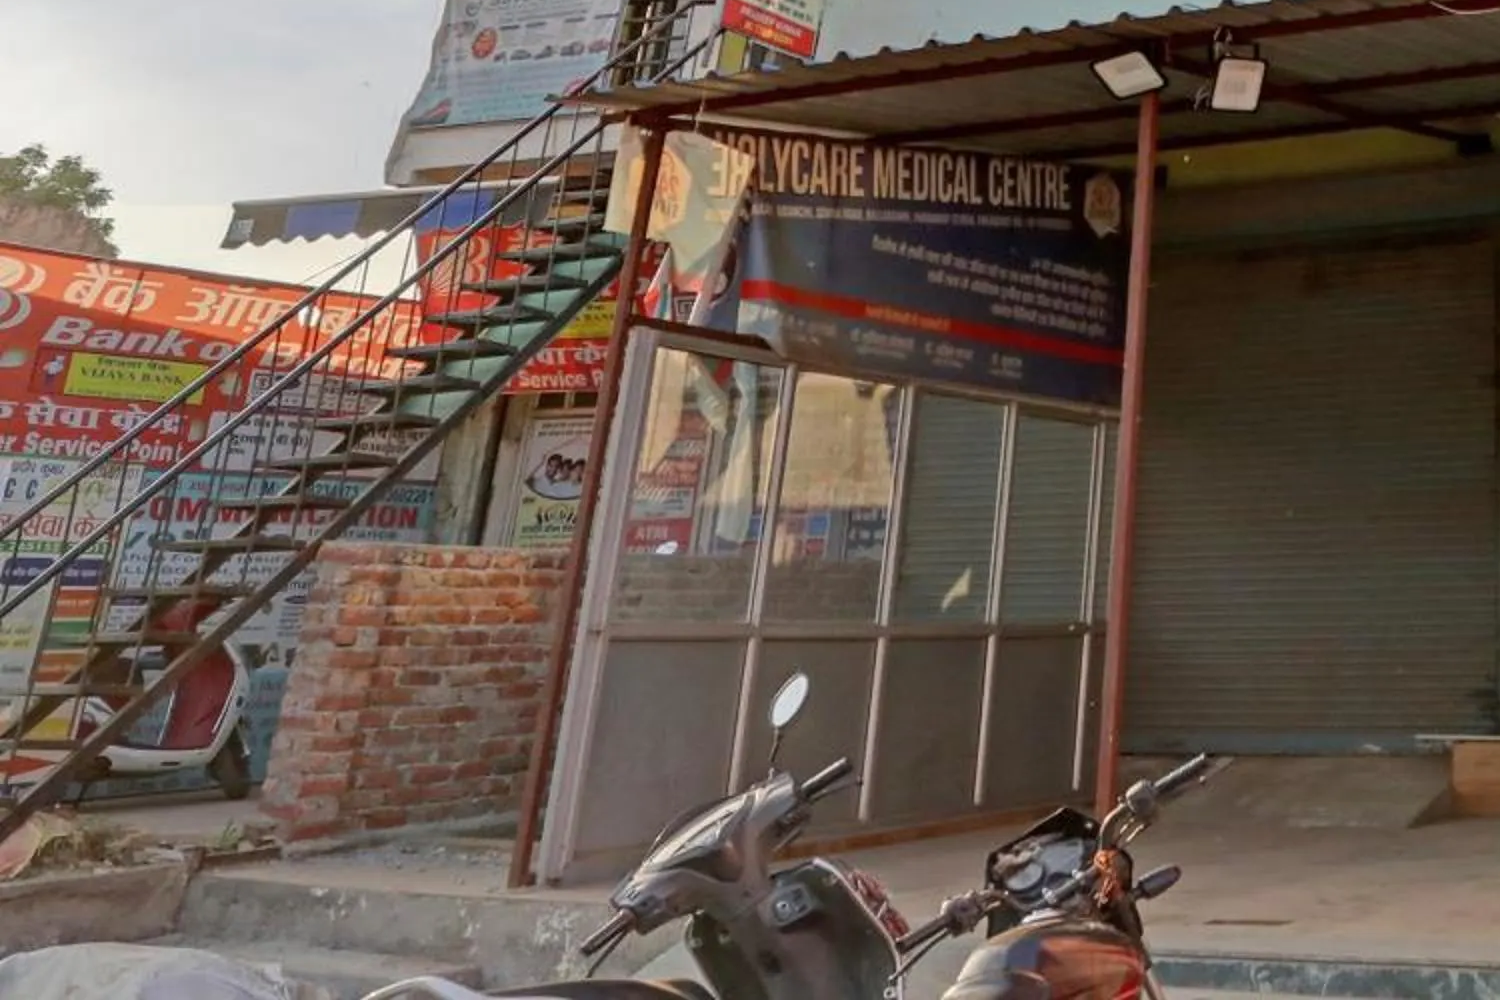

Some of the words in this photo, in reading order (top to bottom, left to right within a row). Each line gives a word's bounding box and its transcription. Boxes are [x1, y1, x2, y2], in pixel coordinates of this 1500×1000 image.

[873, 147, 982, 206] MEDICAL
[987, 157, 1072, 211] CENTRE
[63, 261, 165, 314] बैंक
[41, 315, 193, 358] Bank
[519, 369, 587, 390] Service
